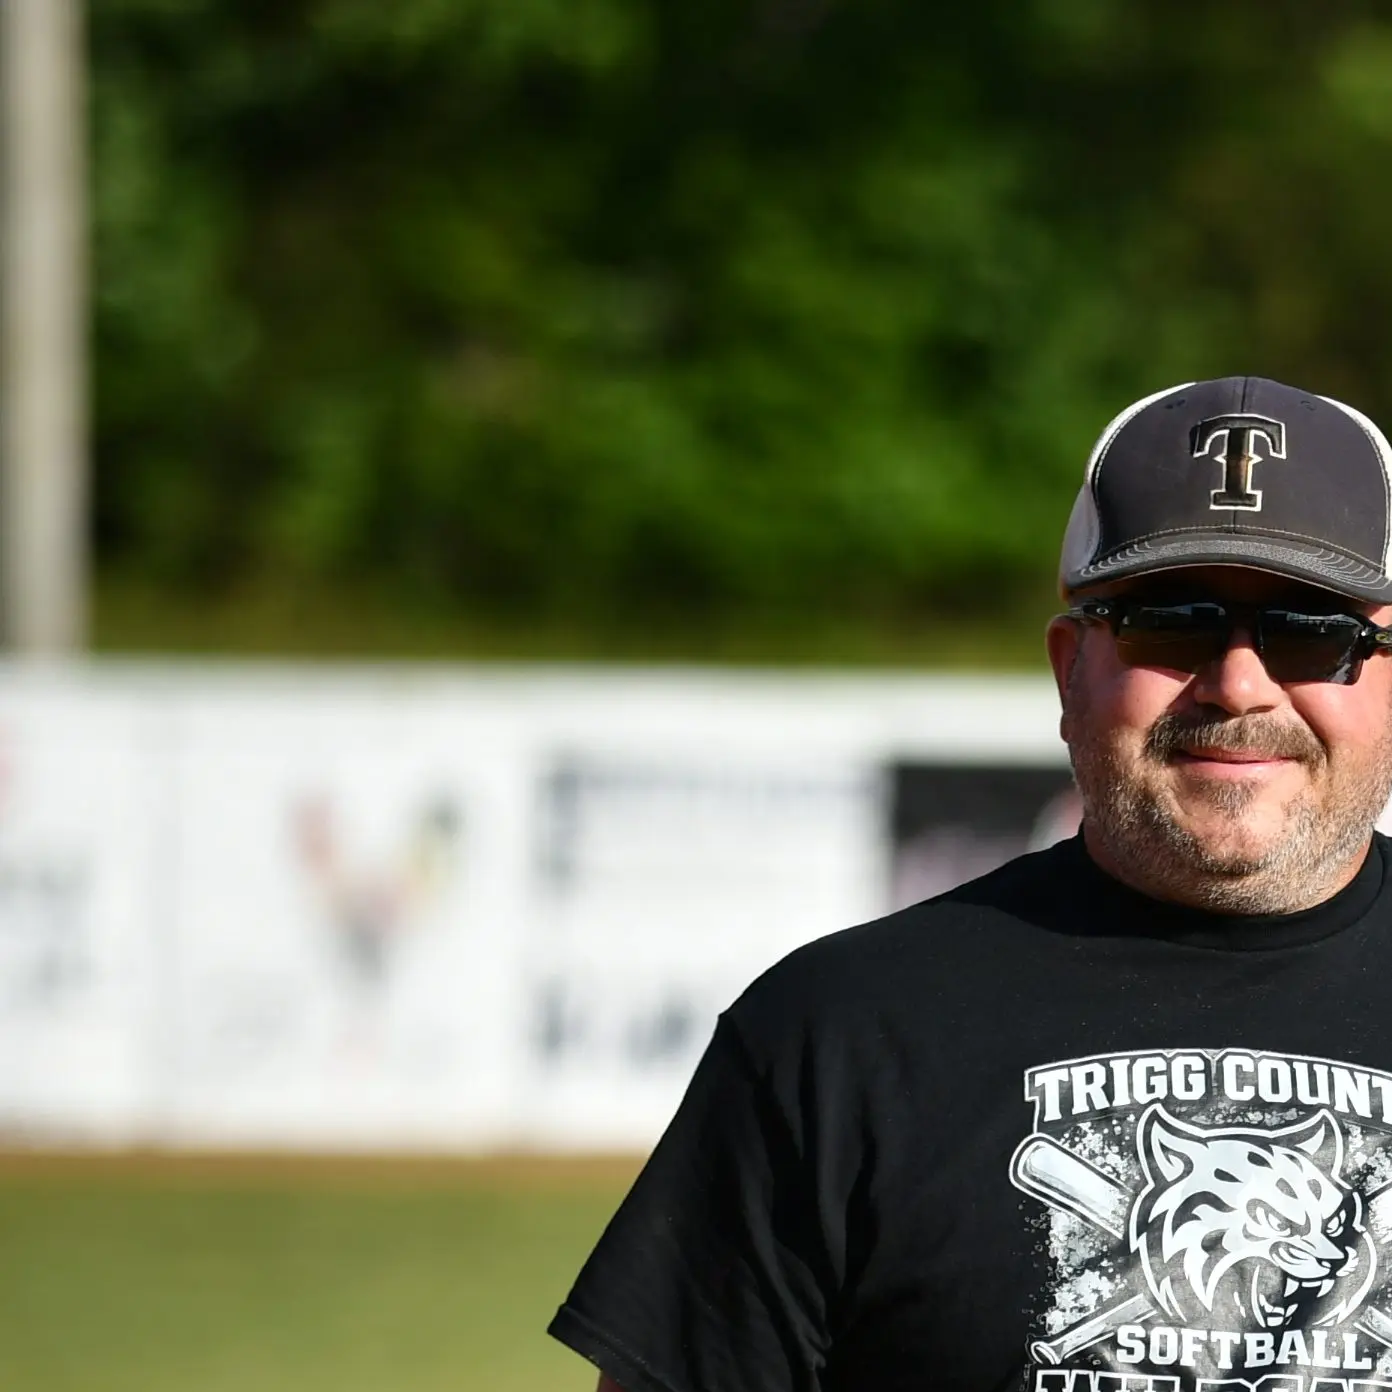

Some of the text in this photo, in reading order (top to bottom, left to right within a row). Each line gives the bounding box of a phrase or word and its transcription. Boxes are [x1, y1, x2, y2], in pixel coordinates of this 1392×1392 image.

[1191, 413, 1287, 512] T
[1034, 1055, 1207, 1122] TRIGG
[1116, 1326, 1373, 1370] SOFTBALL
